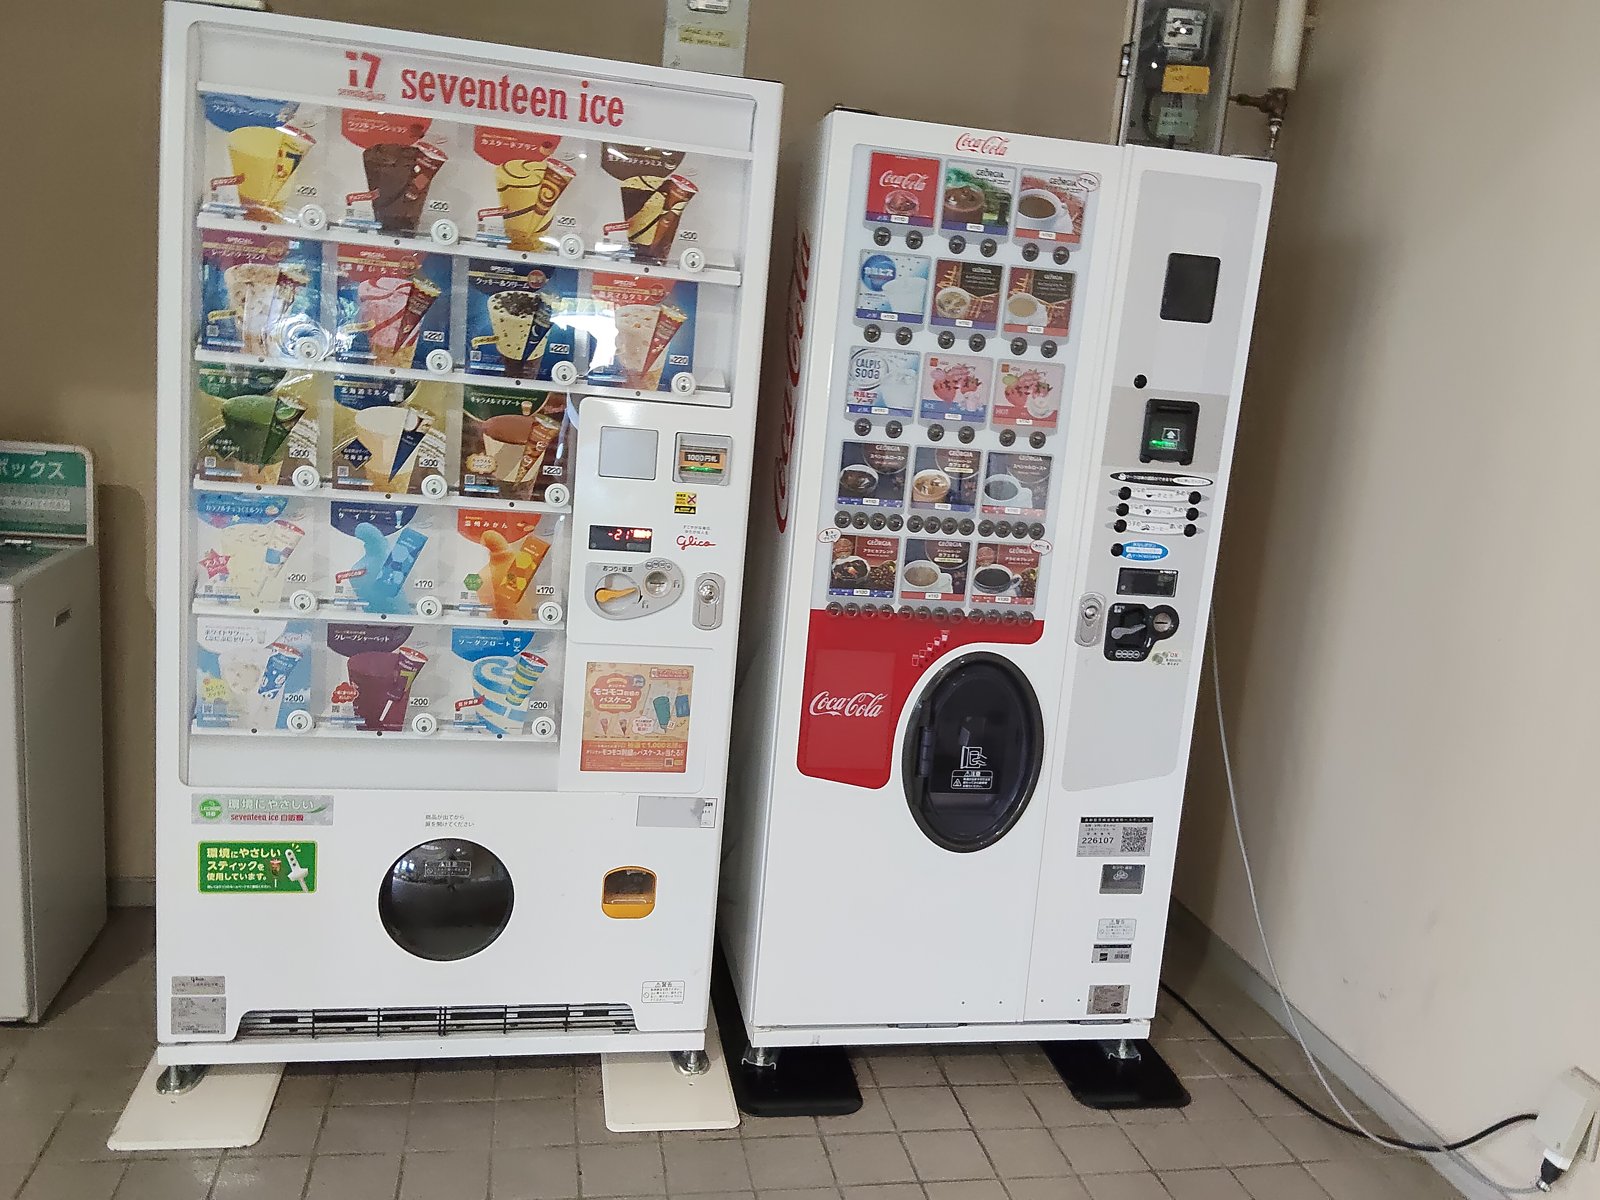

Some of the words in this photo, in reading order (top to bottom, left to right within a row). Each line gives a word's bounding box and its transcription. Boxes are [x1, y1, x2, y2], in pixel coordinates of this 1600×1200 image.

[402, 69, 567, 119] seventeen
[579, 80, 624, 127] ice
[480, 138, 538, 151] カスタードプリン
[855, 358, 881, 370] CALPIS
[676, 536, 717, 550] Glico
[867, 538, 892, 547] GEORGIA
[537, 586, 555, 594] ¥170
[458, 639, 511, 647] ソーダフロート
[285, 694, 304, 702] ¥200
[410, 698, 429, 706] ¥200
[530, 701, 548, 709] ¥200
[809, 690, 888, 718] Coca-Cola
[227, 798, 315, 810] 環境にやさしい
[230, 813, 268, 822] seventeen
[268, 812, 279, 822] ice
[1081, 836, 1114, 845] 226107
[206, 847, 281, 859] 環境にやさしい
[206, 860, 266, 872] スティックを
[206, 872, 267, 881] 使用しています。
